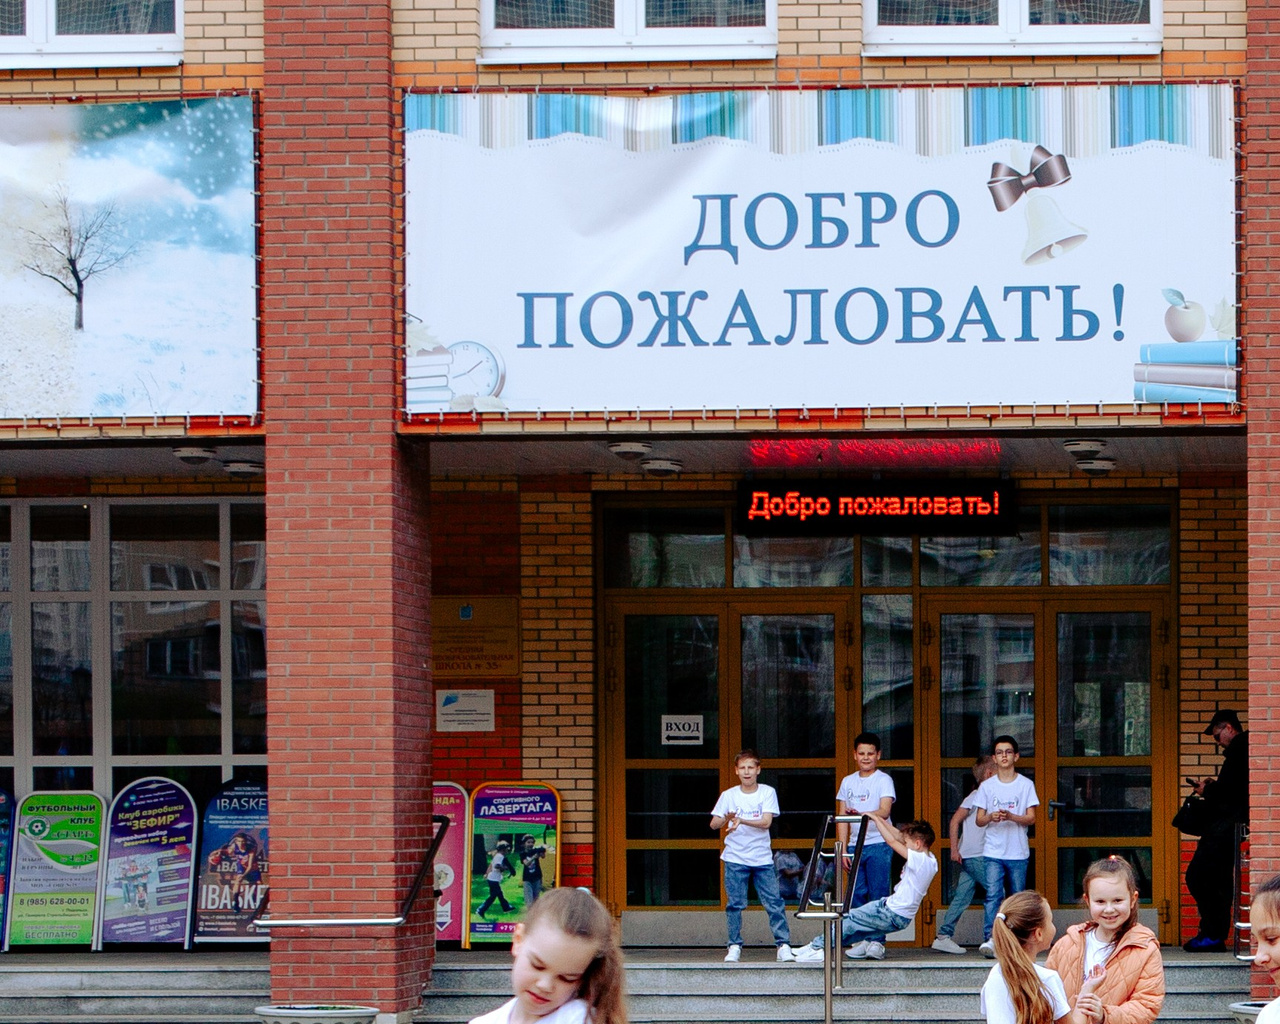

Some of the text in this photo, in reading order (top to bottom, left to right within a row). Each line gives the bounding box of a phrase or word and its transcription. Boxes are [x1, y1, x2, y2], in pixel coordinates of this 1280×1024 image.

[684, 189, 960, 265] ДОБРО
[516, 283, 1127, 349] ПОЖАЛОВАТЬ!
[748, 491, 999, 521] Добро пожаловать!
[665, 721, 700, 733] ВХОД
[27, 804, 96, 812] ФУТБОЛЬНЫЙ
[216, 798, 267, 811] IBASKE
[480, 802, 553, 816] ЛАЗЕРТАГА
[118, 804, 184, 820] Клуб аэробики
[161, 836, 168, 845] 5
[19, 898, 24, 906] 8
[25, 931, 78, 939] БЕСПЛАТНО
